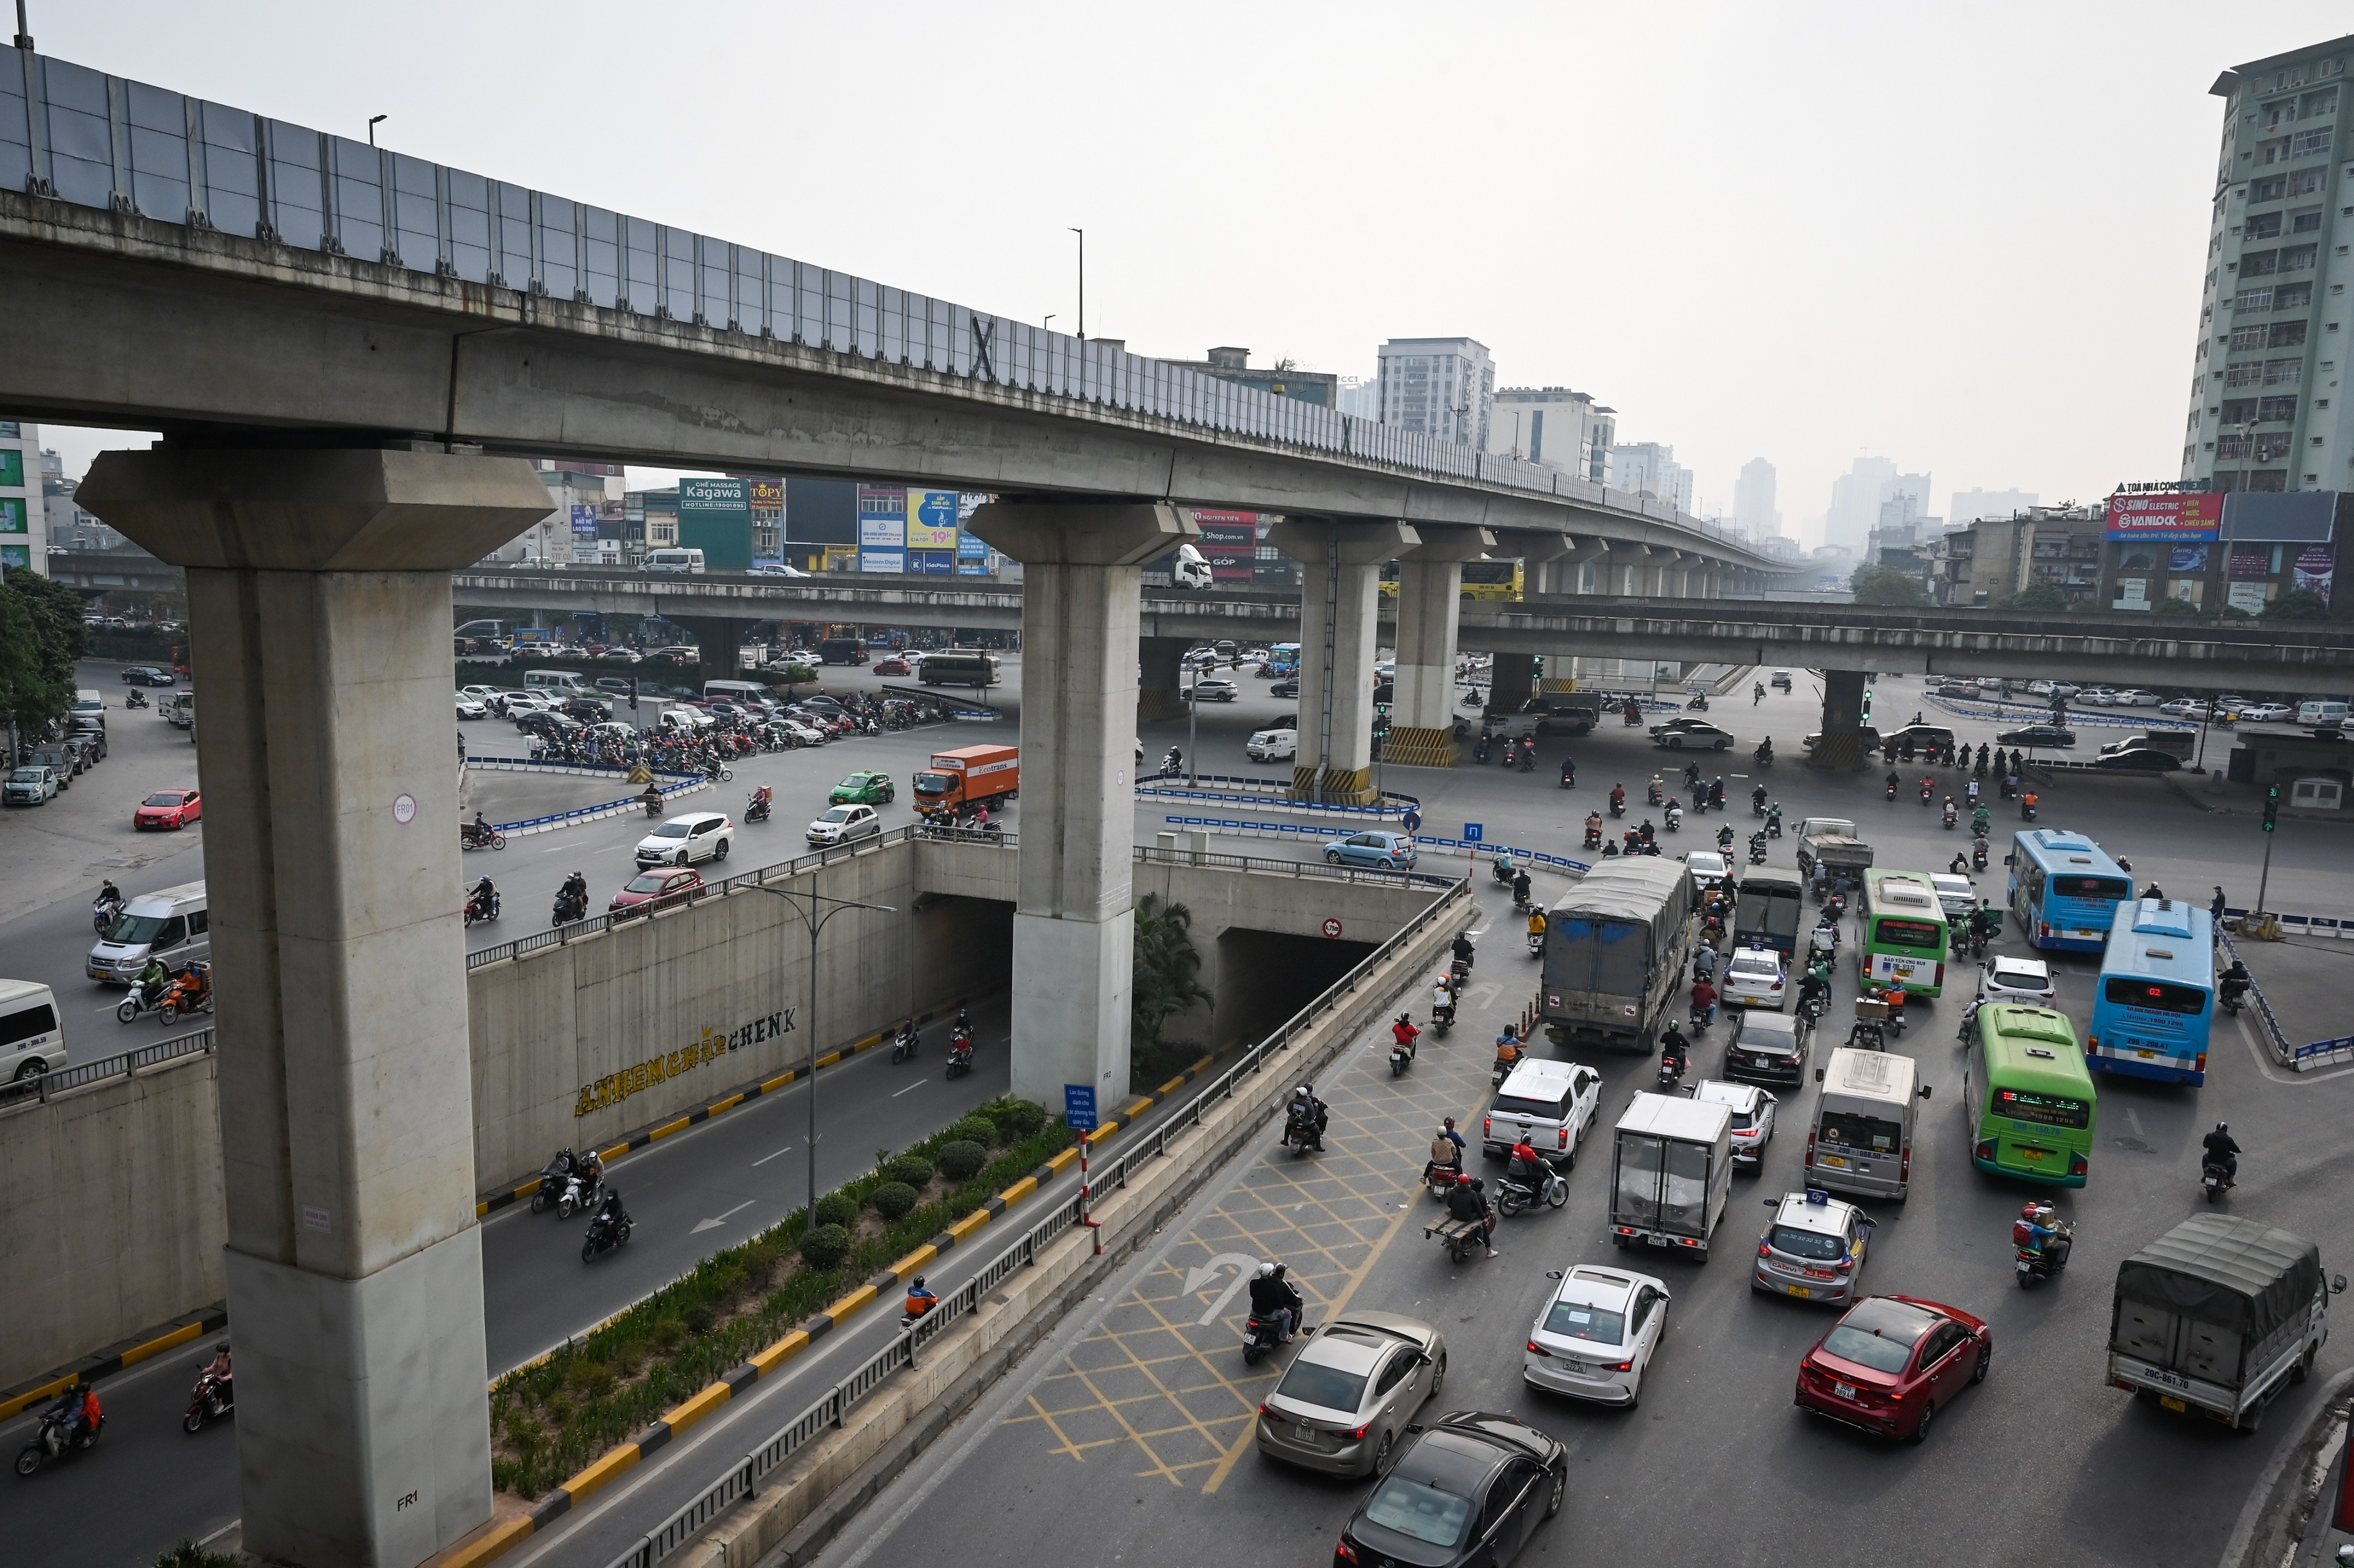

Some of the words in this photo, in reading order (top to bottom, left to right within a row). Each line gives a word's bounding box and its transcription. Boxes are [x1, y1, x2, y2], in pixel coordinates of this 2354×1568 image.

[686, 487, 741, 500] Kagawa
[752, 488, 782, 497] TOPY
[2126, 500, 2149, 510] SINO
[2131, 516, 2177, 526] VANLOCK
[1207, 532, 1244, 541] Shop.com.vn
[979, 763, 1007, 774] Ecotrans
[397, 803, 413, 815] FR01
[727, 1007, 797, 1052] CHENK
[1811, 1192, 1823, 1202] G7
[1772, 1262, 1797, 1272] CADIVI
[2145, 1368, 2189, 1389] 29C-861.70
[398, 1490, 417, 1512] FR1
